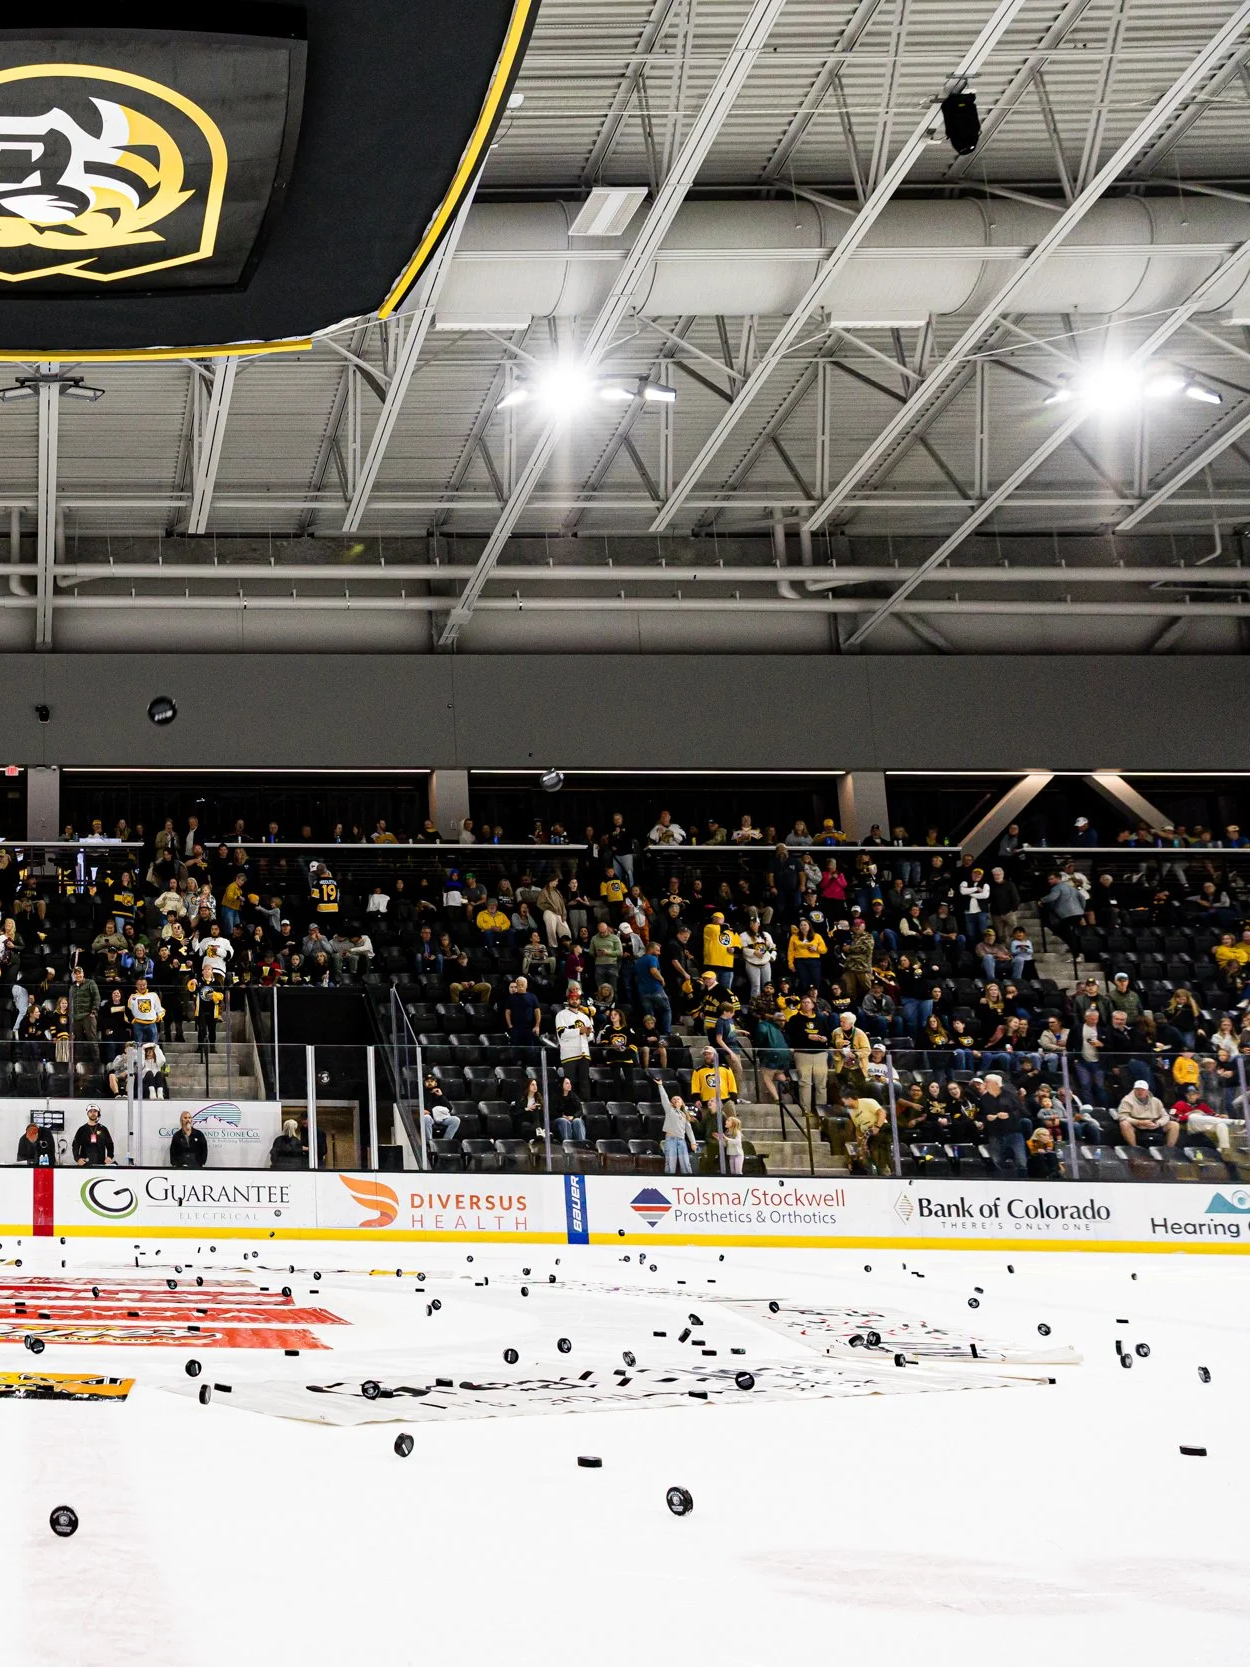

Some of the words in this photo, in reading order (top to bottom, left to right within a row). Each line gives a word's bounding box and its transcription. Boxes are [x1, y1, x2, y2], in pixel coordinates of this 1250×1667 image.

[322, 884, 337, 901] 19
[221, 1129, 245, 1138] STONE
[410, 1193, 527, 1211] DIVERSUS
[918, 1196, 974, 1219] Bank
[979, 1196, 1001, 1219] of
[1006, 1198, 1111, 1221] Colorado
[179, 1212, 259, 1221] ELECTRICAL
[412, 1214, 528, 1231] HEALTH
[674, 1209, 752, 1223] Prosthetics
[756, 1210, 766, 1223] &
[770, 1210, 837, 1224] Orthotics
[941, 1222, 1004, 1230] THERE'S
[1014, 1222, 1051, 1231] ONLY
[1062, 1223, 1091, 1231] ONE
[1150, 1217, 1240, 1238] Hearing
